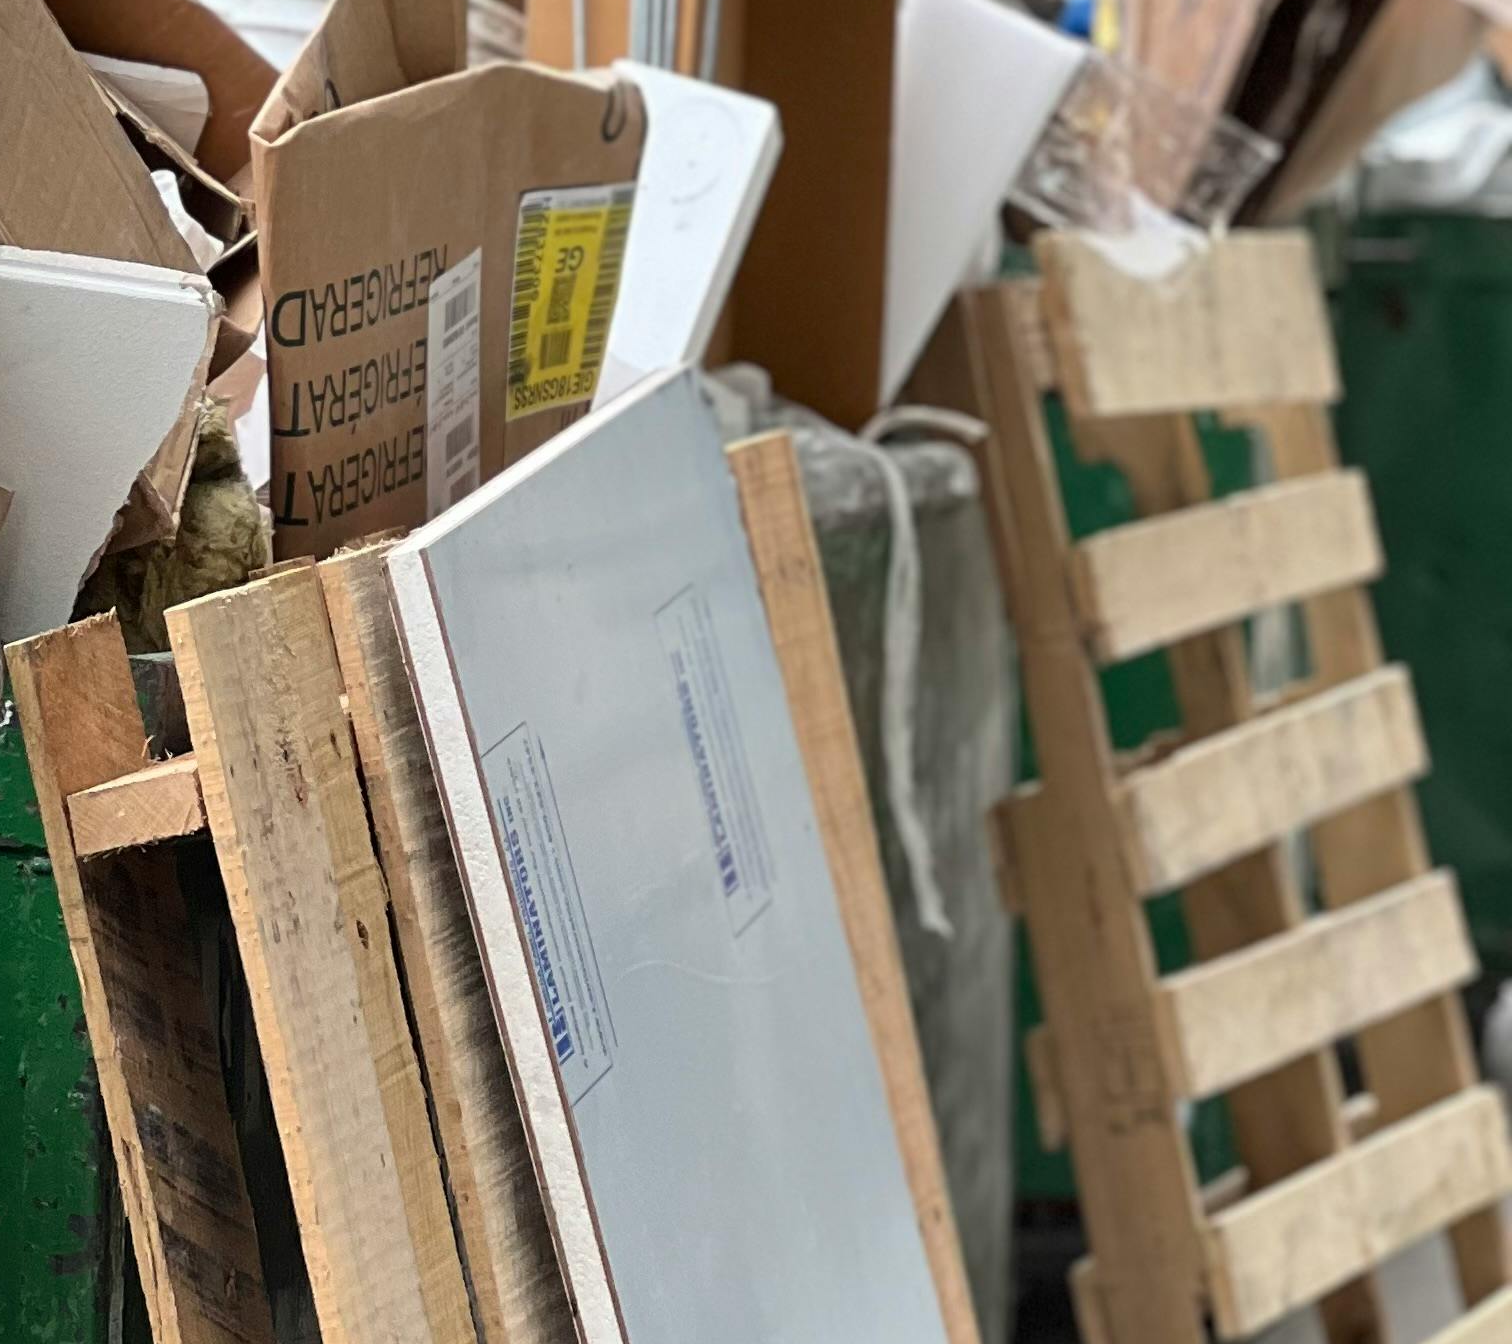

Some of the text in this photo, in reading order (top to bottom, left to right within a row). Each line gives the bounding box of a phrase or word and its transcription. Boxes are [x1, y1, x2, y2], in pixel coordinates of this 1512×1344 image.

[554, 244, 586, 274] GE
[273, 337, 428, 437] ÉFRIGÉRAT
[274, 424, 425, 527] EFRIGERAT
[508, 827, 560, 1006] LAMINATORS
